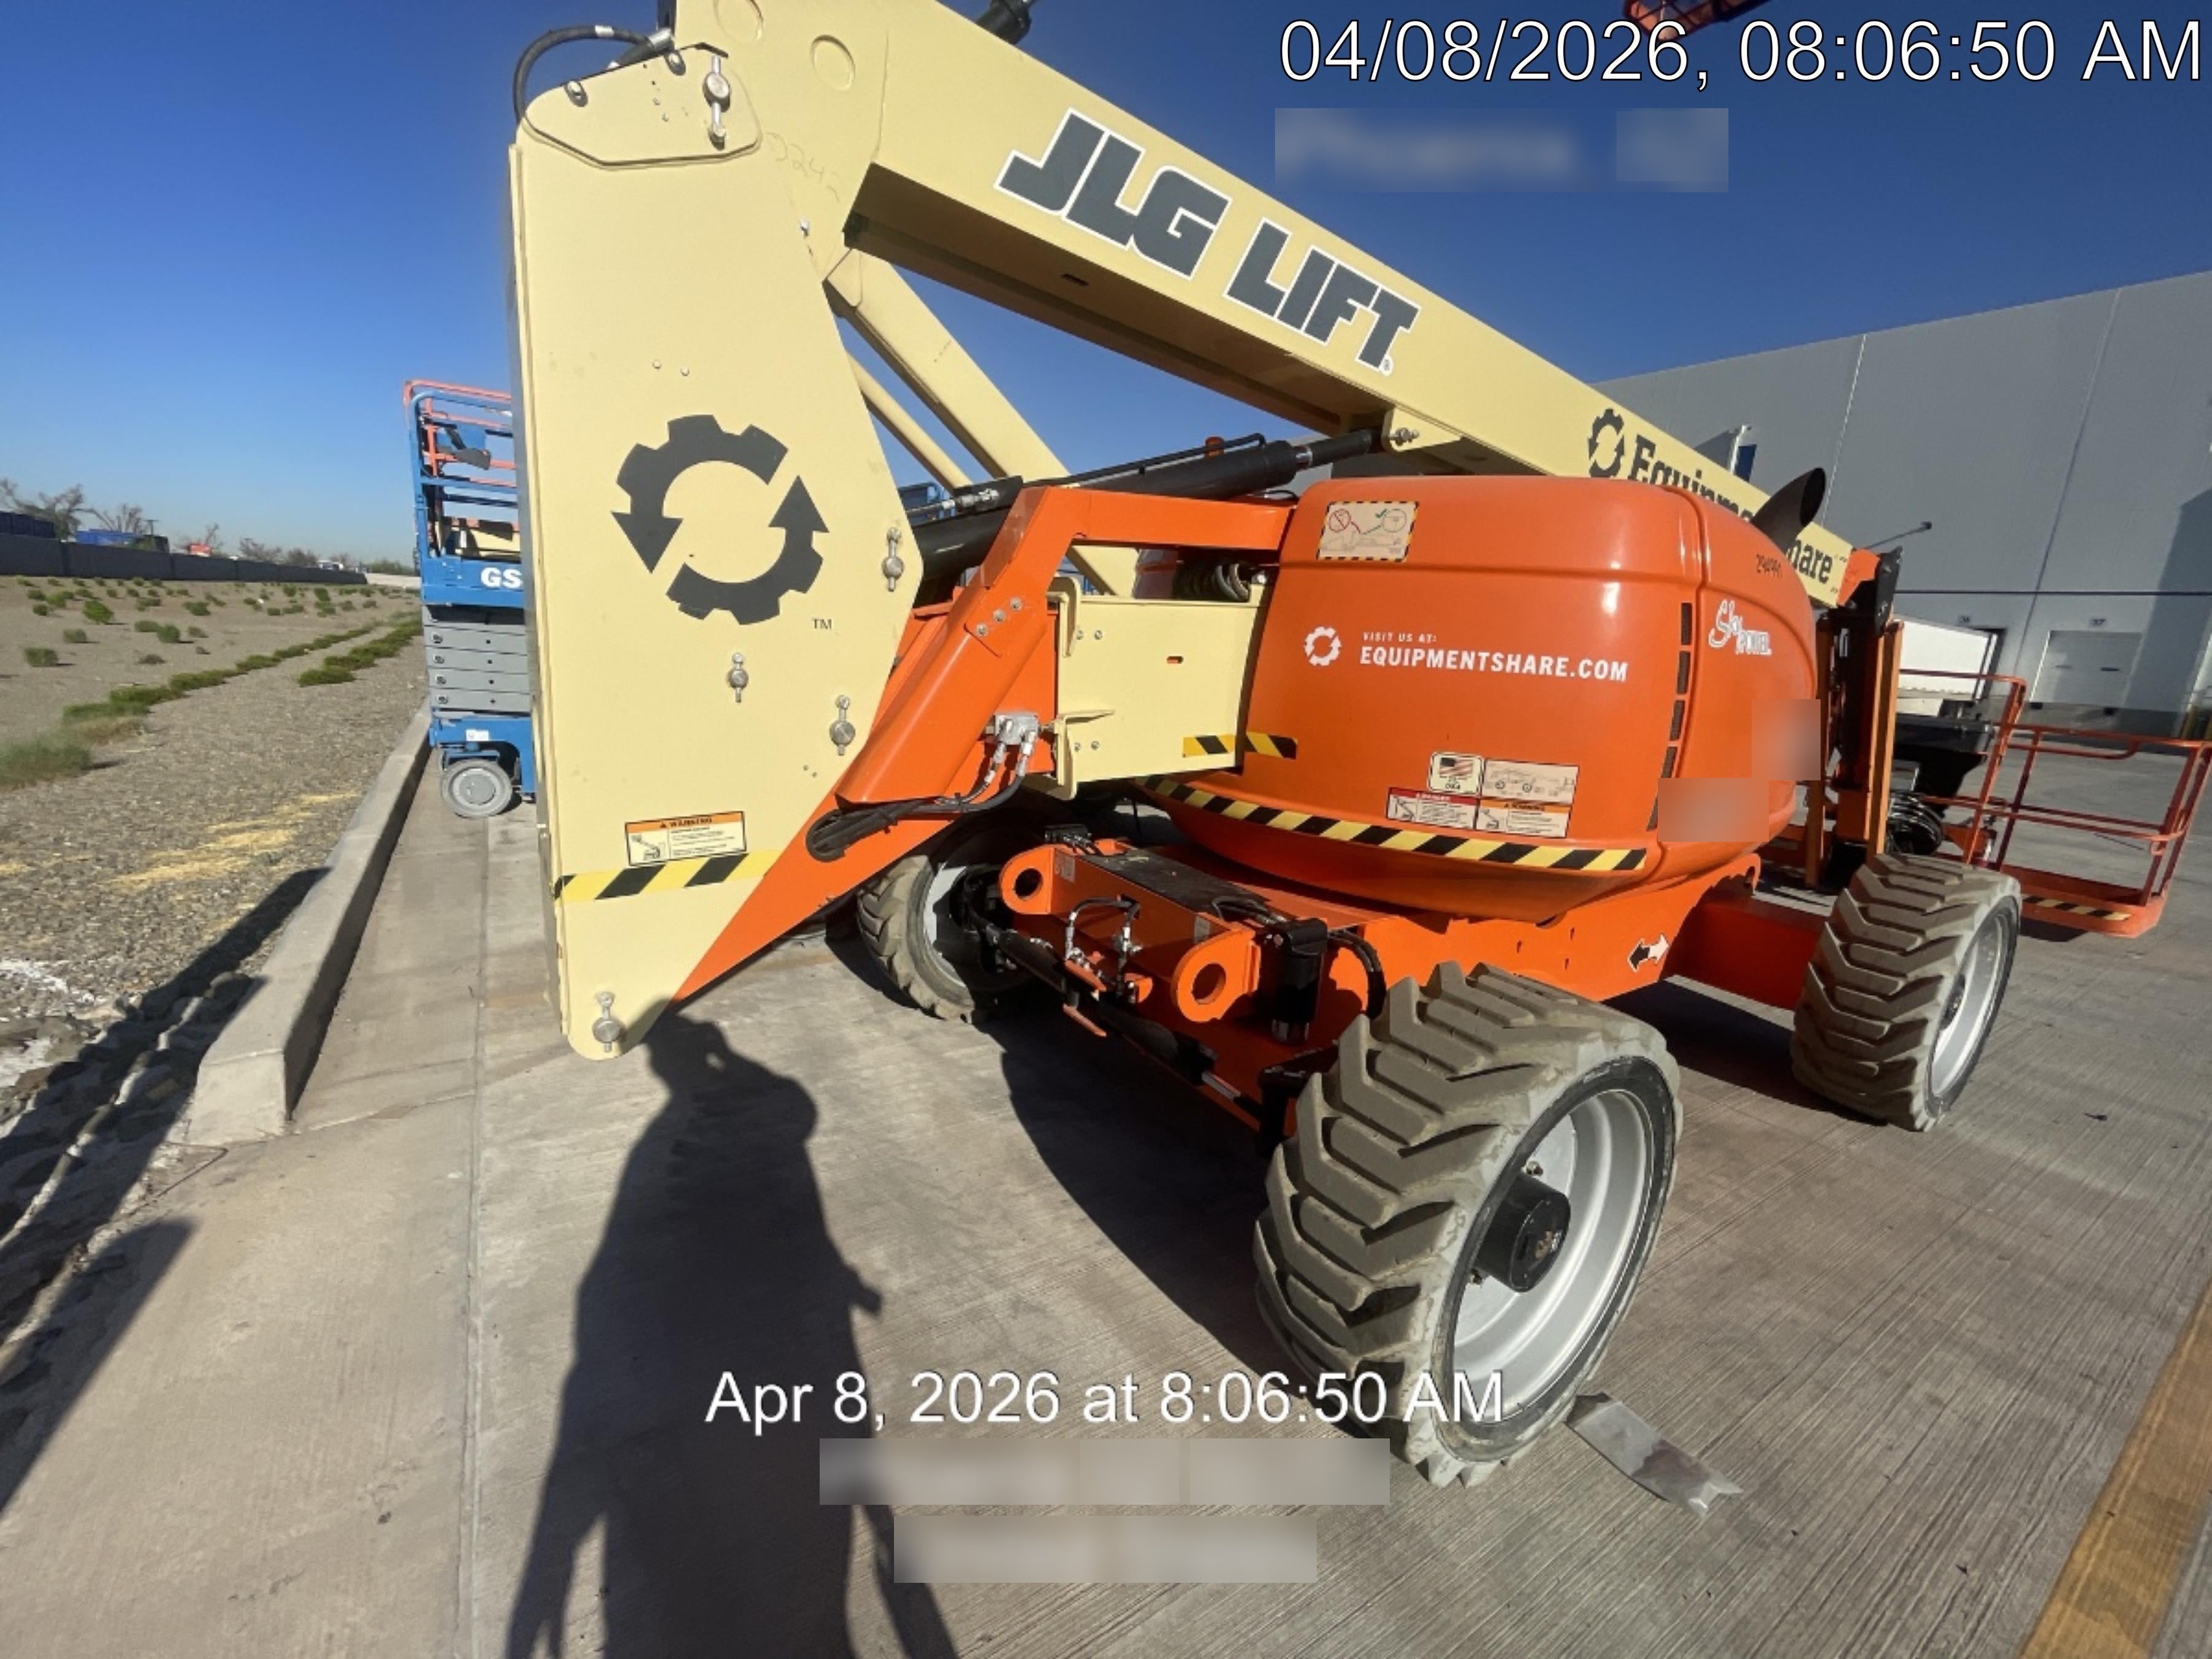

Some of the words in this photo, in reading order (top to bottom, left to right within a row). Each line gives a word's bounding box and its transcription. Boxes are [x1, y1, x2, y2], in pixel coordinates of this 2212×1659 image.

[994, 107, 1232, 280] JLG
[1223, 217, 1421, 371] LIFT
[1363, 632, 1394, 643] VISIT
[1398, 633, 1413, 643] US
[1418, 633, 1437, 644] AT:
[1360, 646, 1628, 683] EQUIPMENTSHARE.COM
